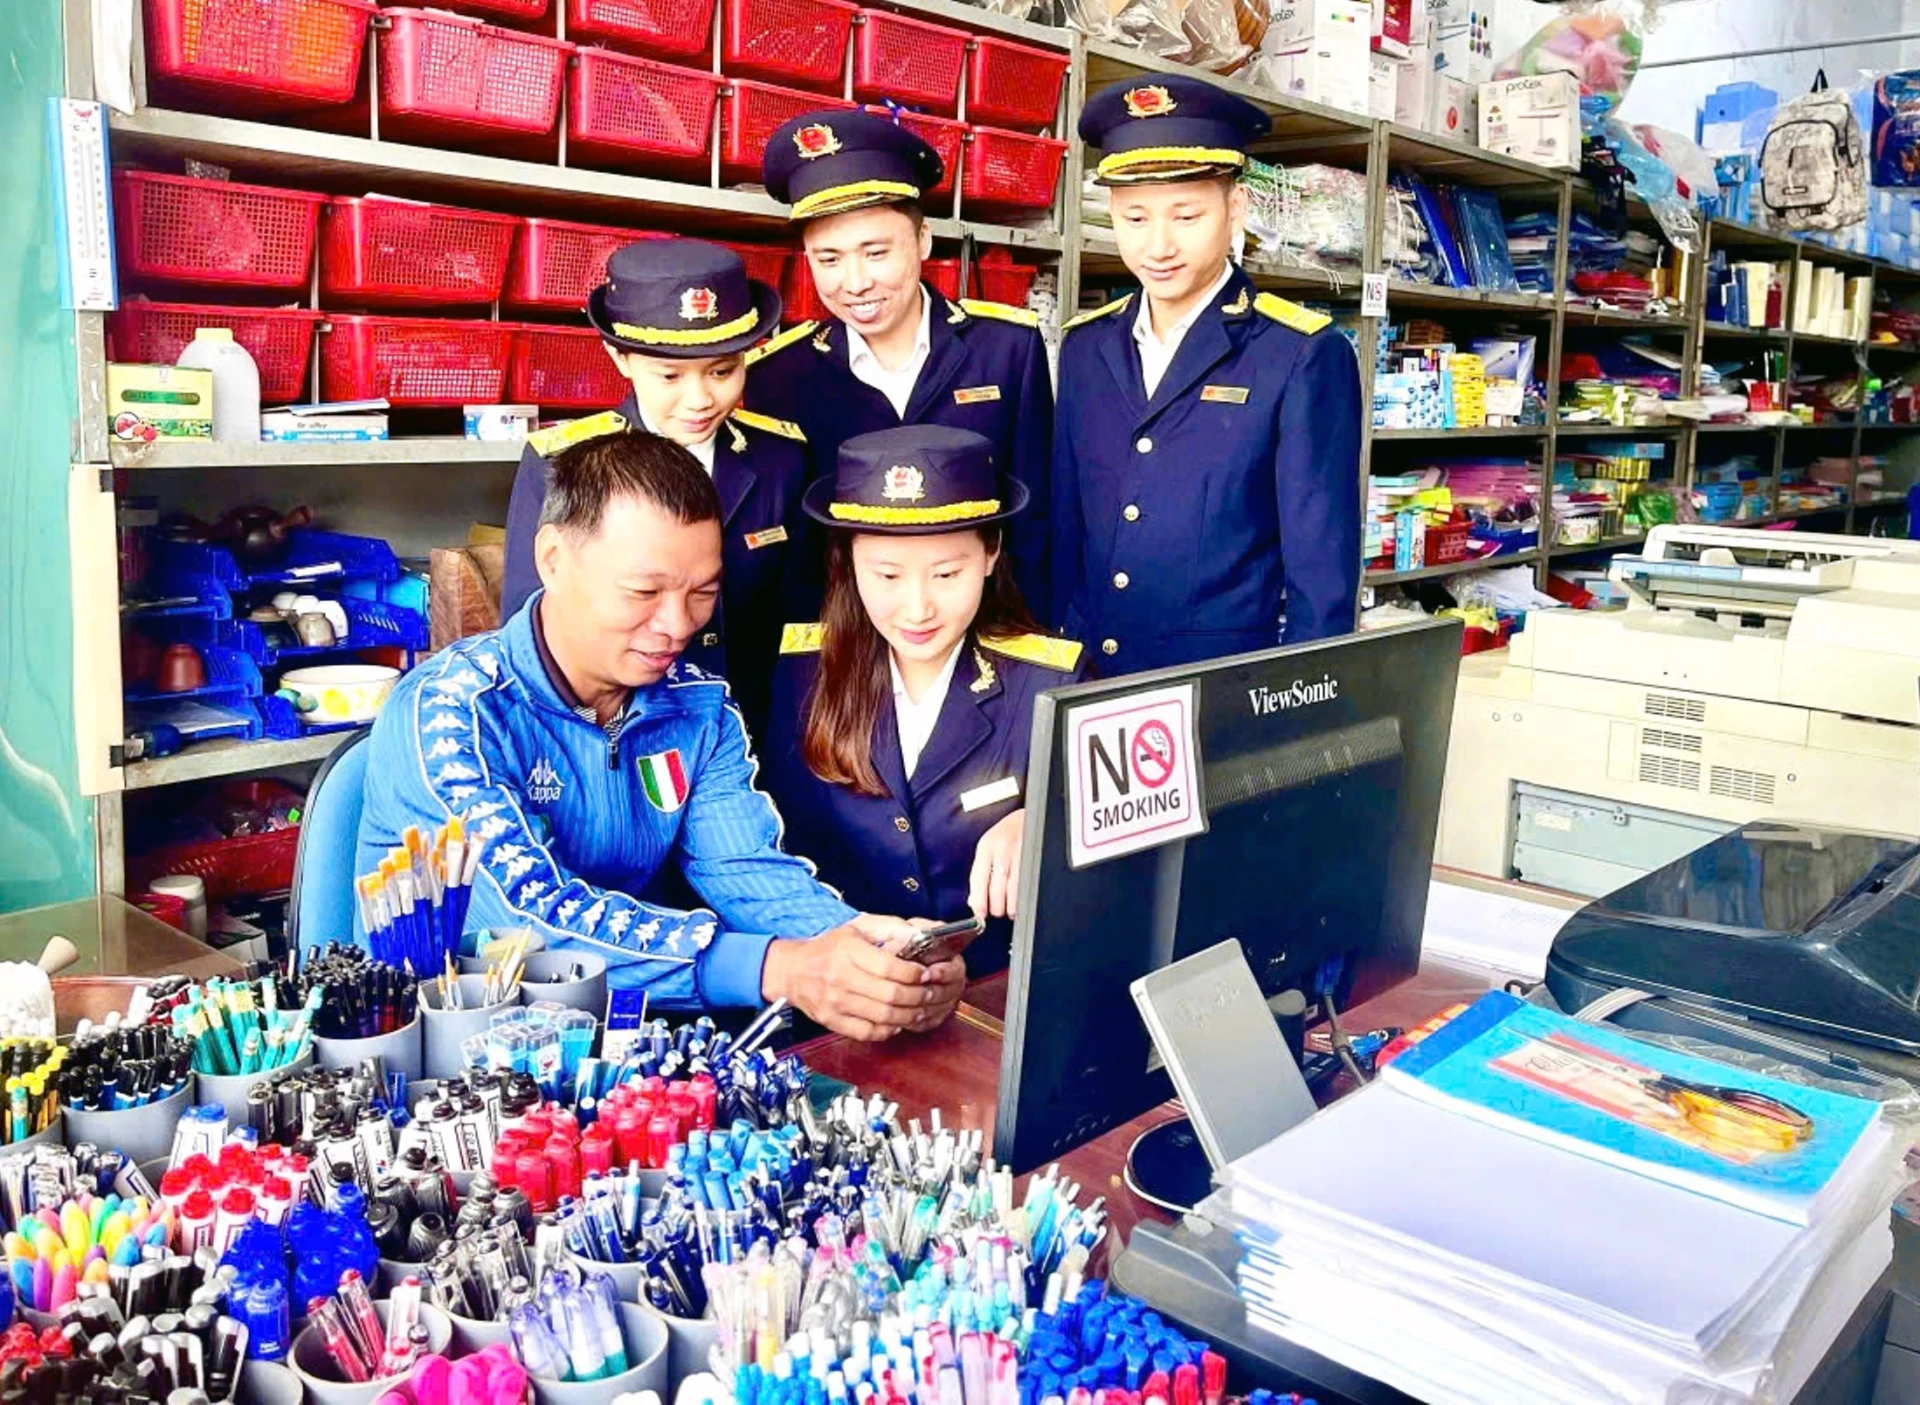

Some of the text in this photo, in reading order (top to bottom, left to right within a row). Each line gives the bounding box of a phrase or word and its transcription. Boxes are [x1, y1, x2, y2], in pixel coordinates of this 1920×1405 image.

[1248, 673, 1338, 716] ViewSonic
[527, 784, 561, 804] Kappa
[1092, 788, 1180, 831] SMOKING
